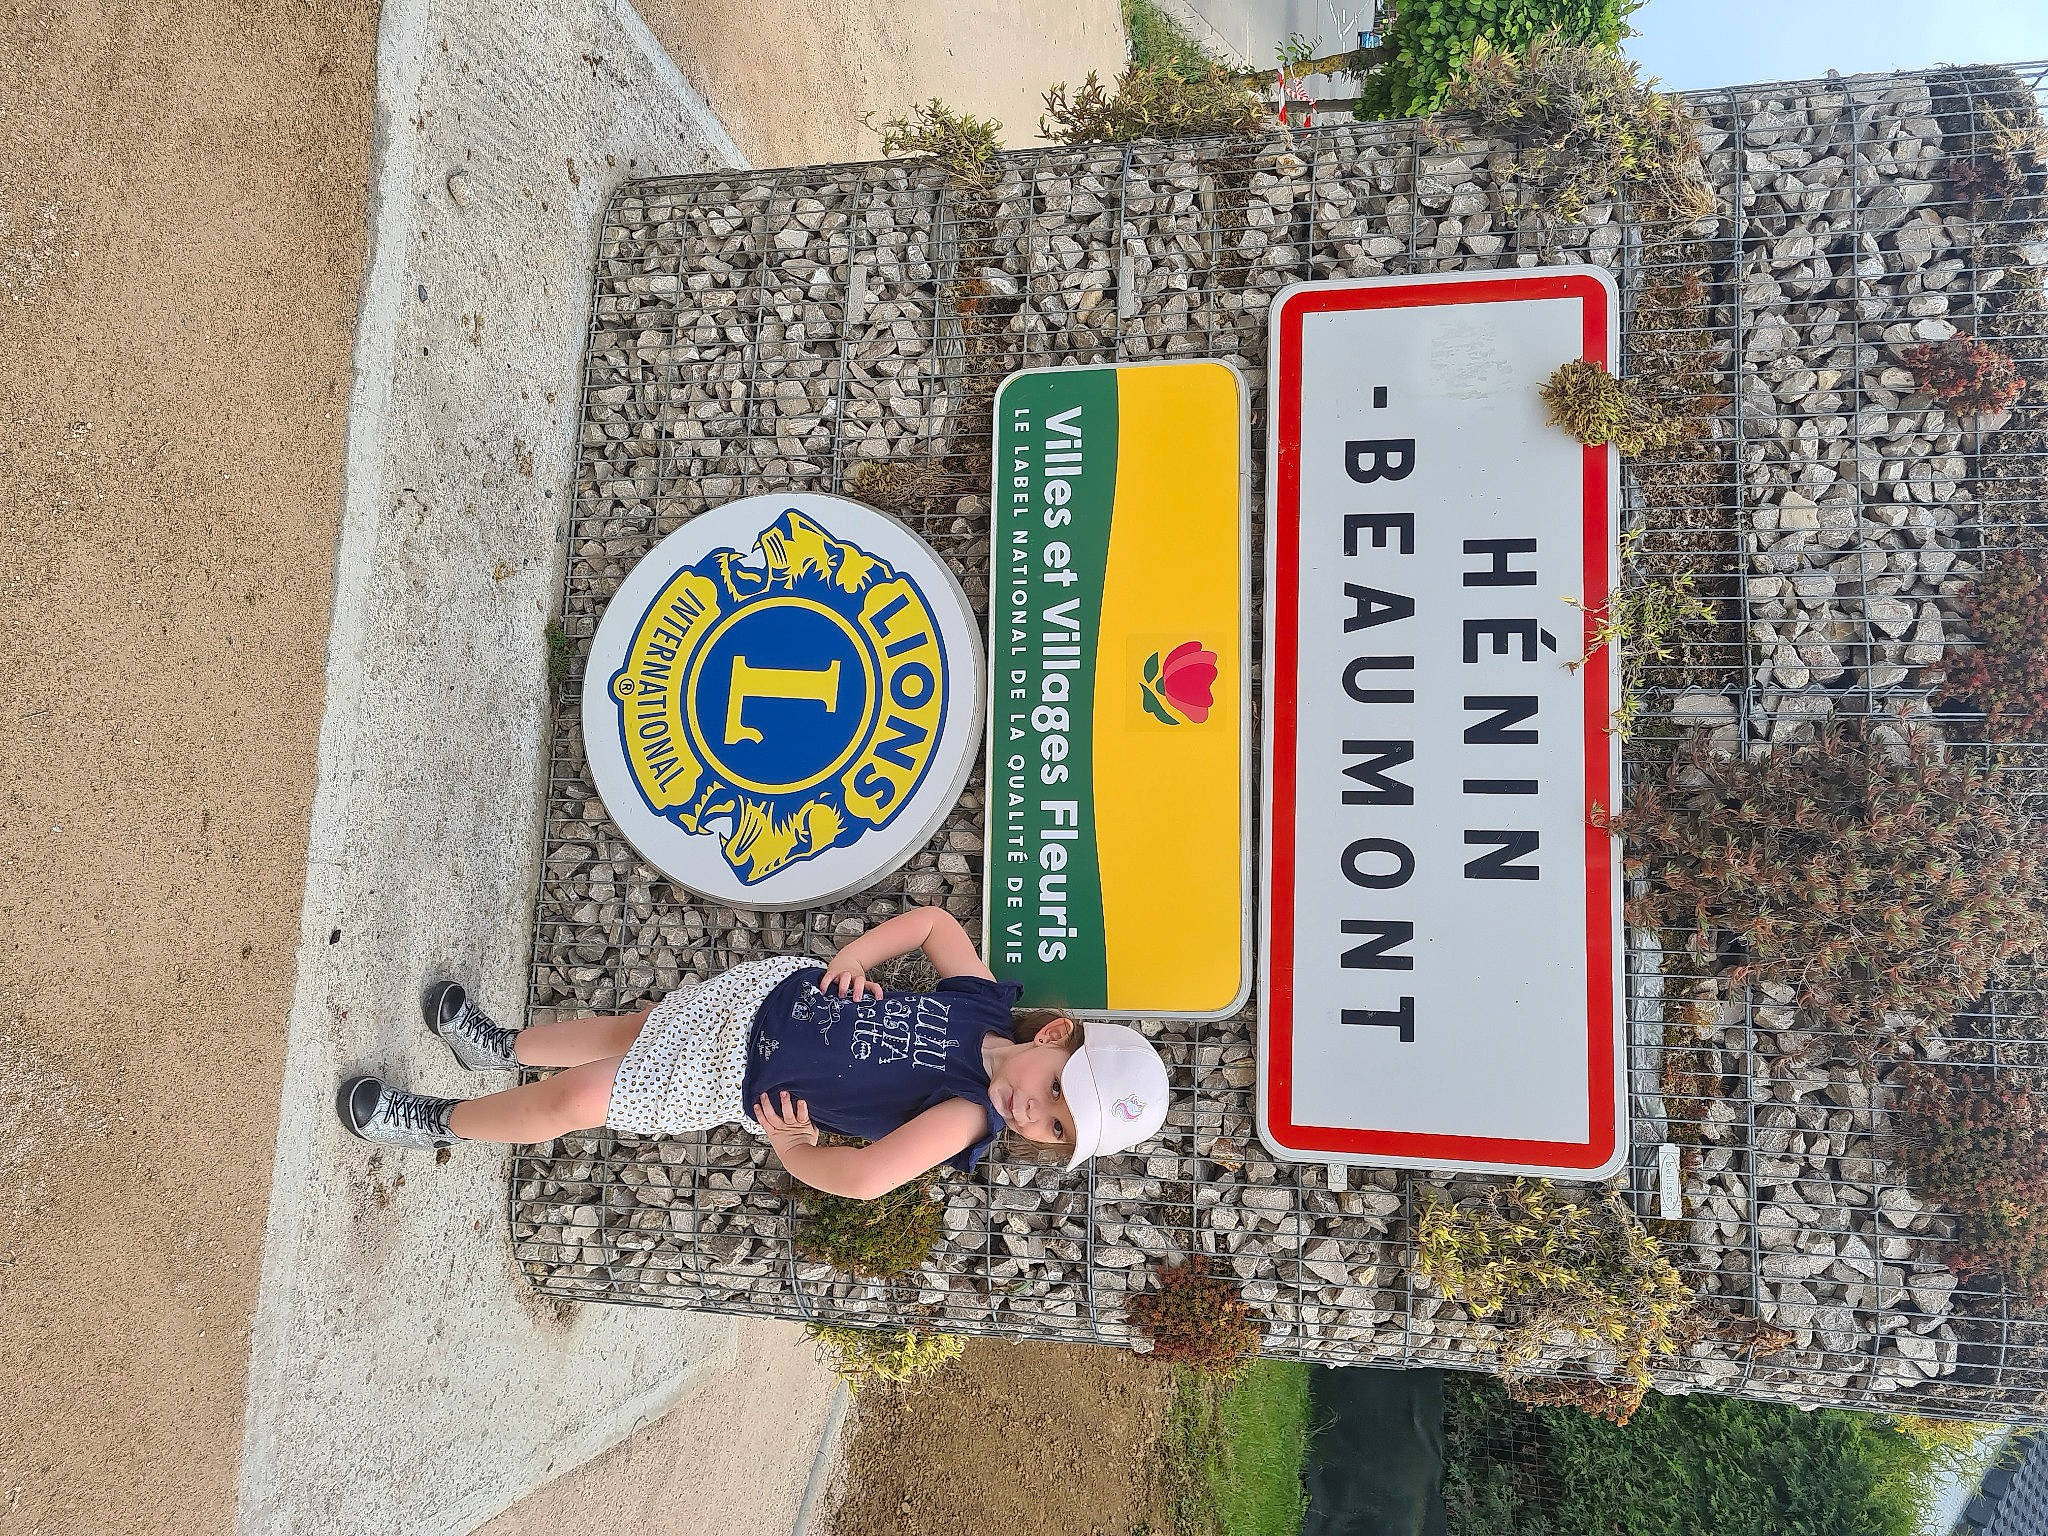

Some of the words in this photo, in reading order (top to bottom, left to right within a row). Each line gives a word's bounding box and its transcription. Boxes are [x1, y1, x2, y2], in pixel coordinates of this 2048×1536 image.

[1015, 409, 1029, 432] LE
[1014, 446, 1029, 517] LABEL
[1044, 406, 1082, 528] Villes
[1012, 531, 1028, 655] NATIONAL
[1044, 542, 1078, 587] et
[637, 587, 710, 793] INTERNATIONAL
[724, 654, 841, 744] L
[853, 593, 936, 809] LIONS
[1010, 715, 1025, 740] LA
[1011, 671, 1026, 698] DE
[1031, 598, 1080, 784] Villages
[1463, 538, 1556, 880] HÉNIN
[1007, 755, 1028, 861] QUALITÉ
[1008, 878, 1022, 907] DE
[1038, 801, 1078, 962] Fleuris
[1007, 923, 1022, 962] VIE
[912, 996, 951, 1072] LULU
